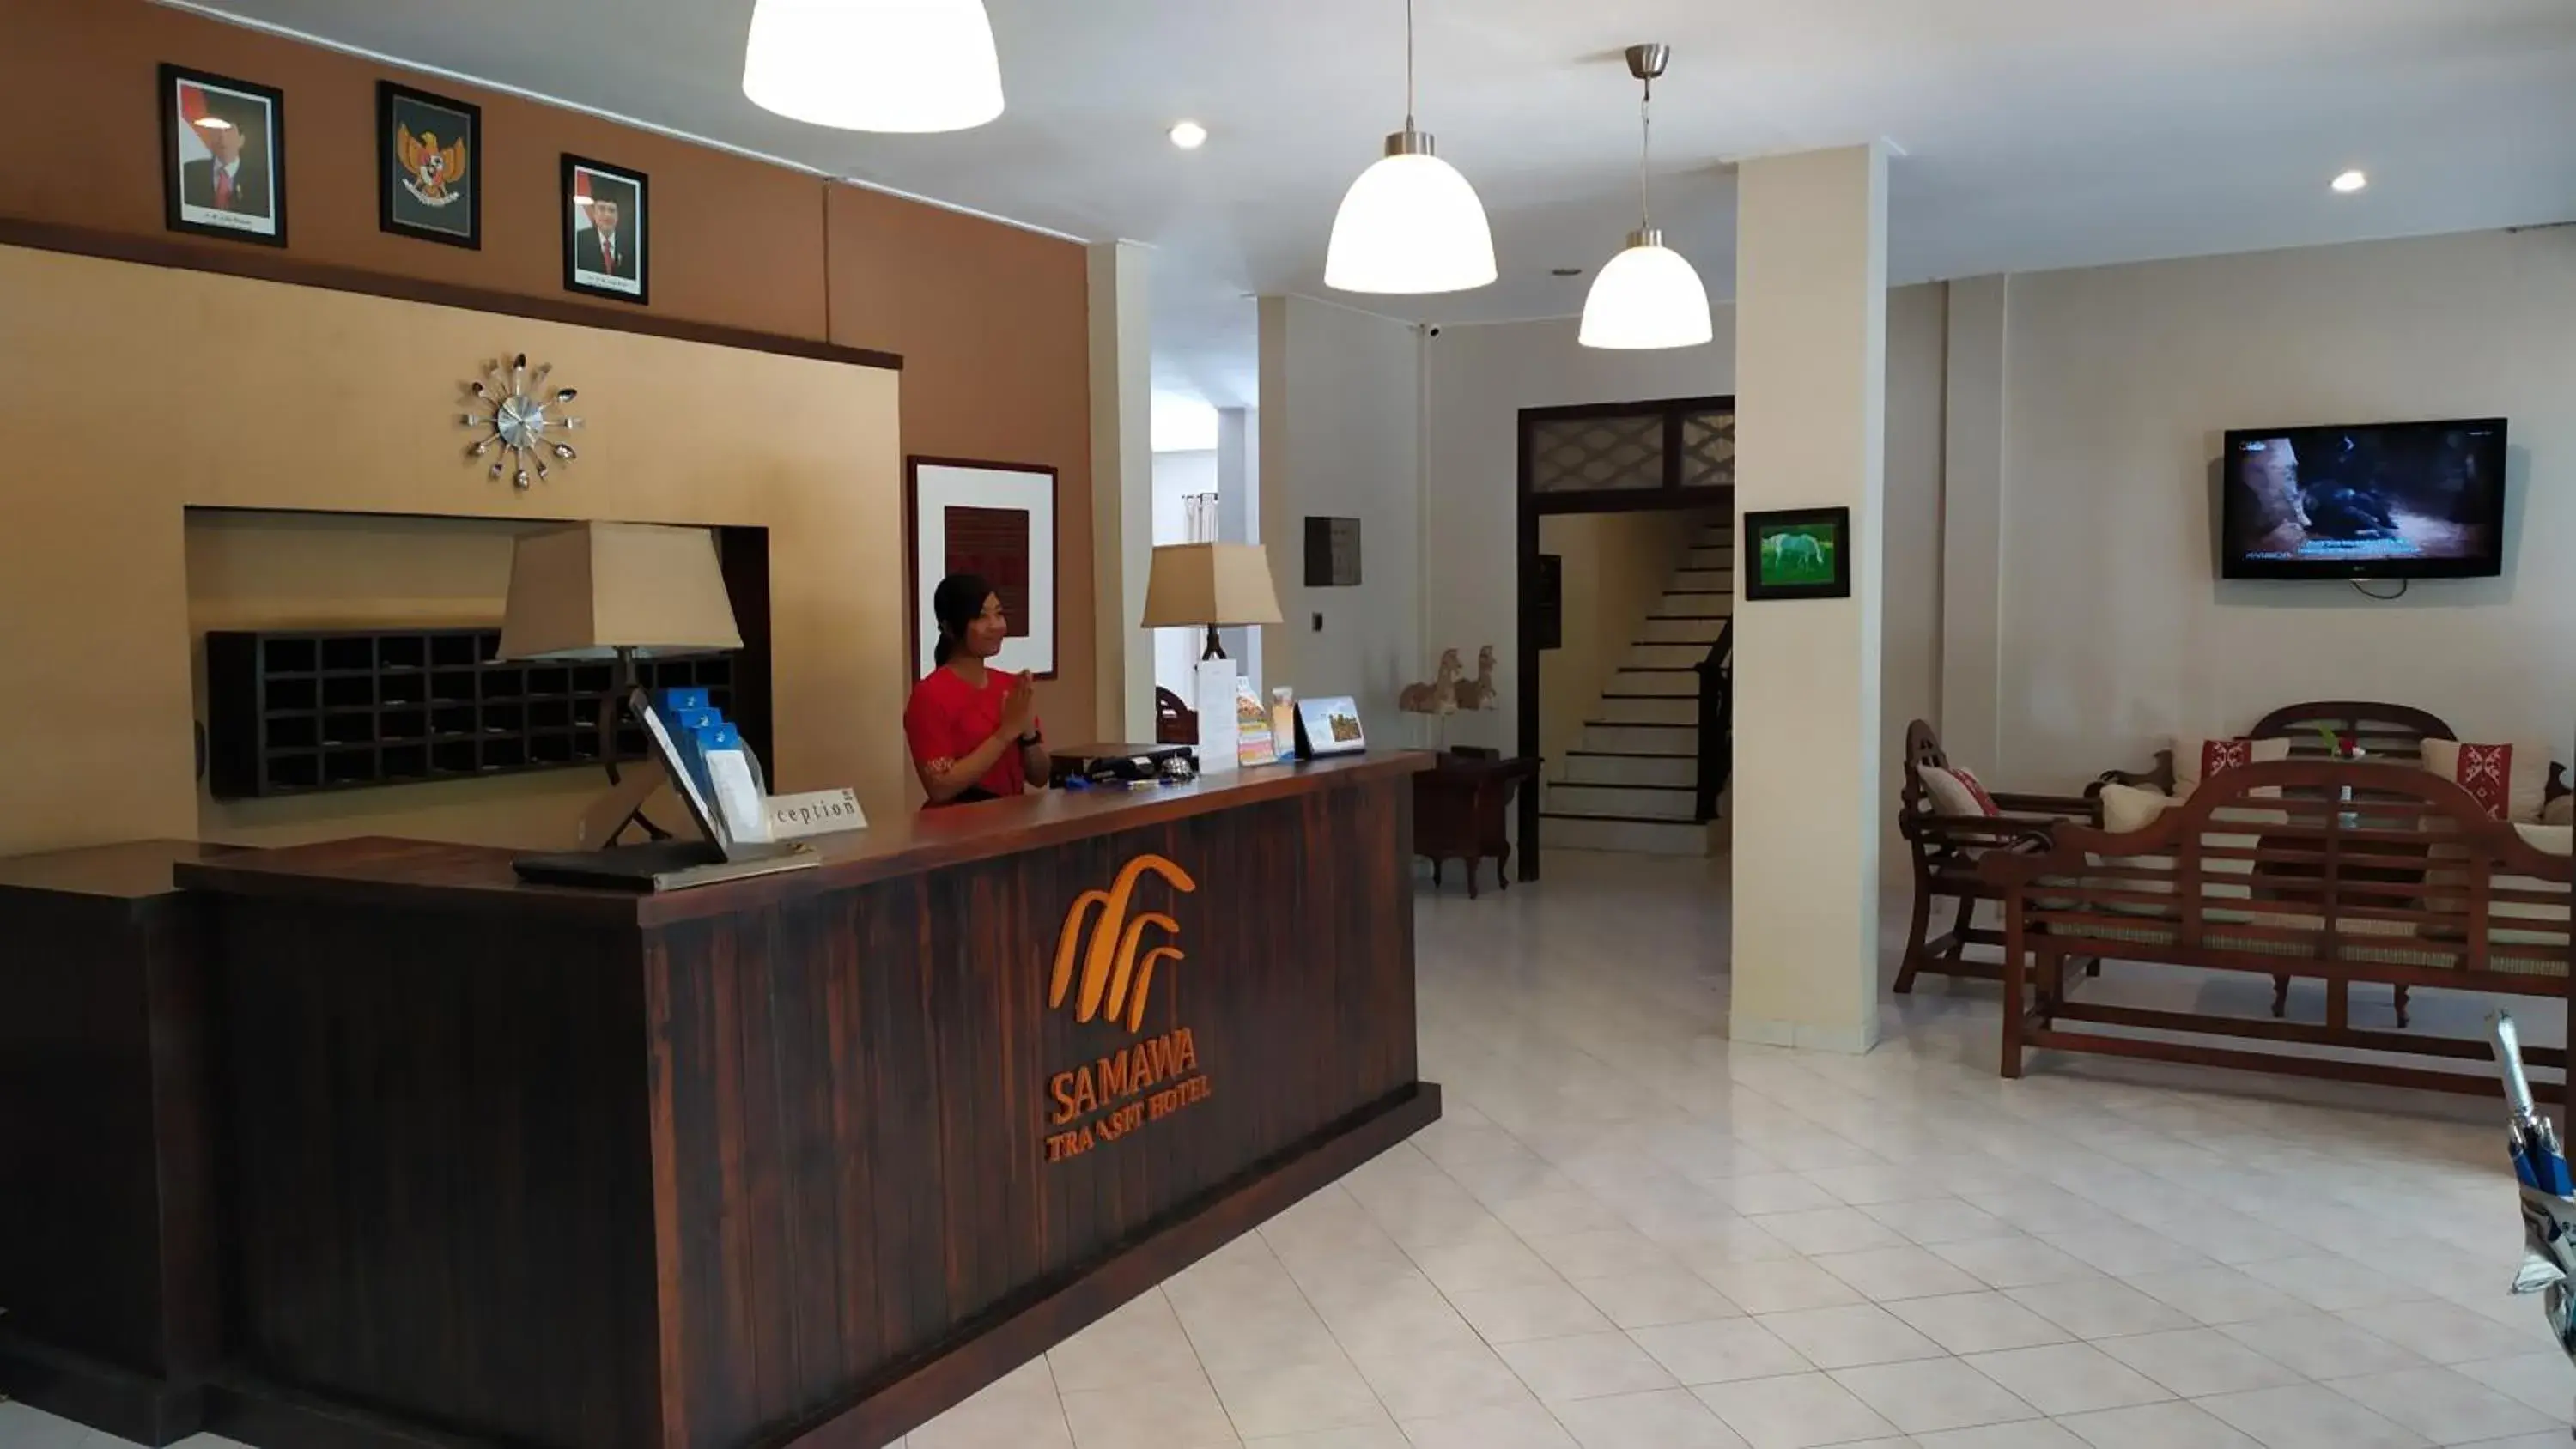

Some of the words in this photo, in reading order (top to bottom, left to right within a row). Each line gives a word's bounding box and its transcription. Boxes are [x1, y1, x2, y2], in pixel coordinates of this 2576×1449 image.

[776, 799, 855, 825] ception
[1051, 1027, 1197, 1125] SAMAWA
[1149, 1075, 1211, 1120] HOTEL
